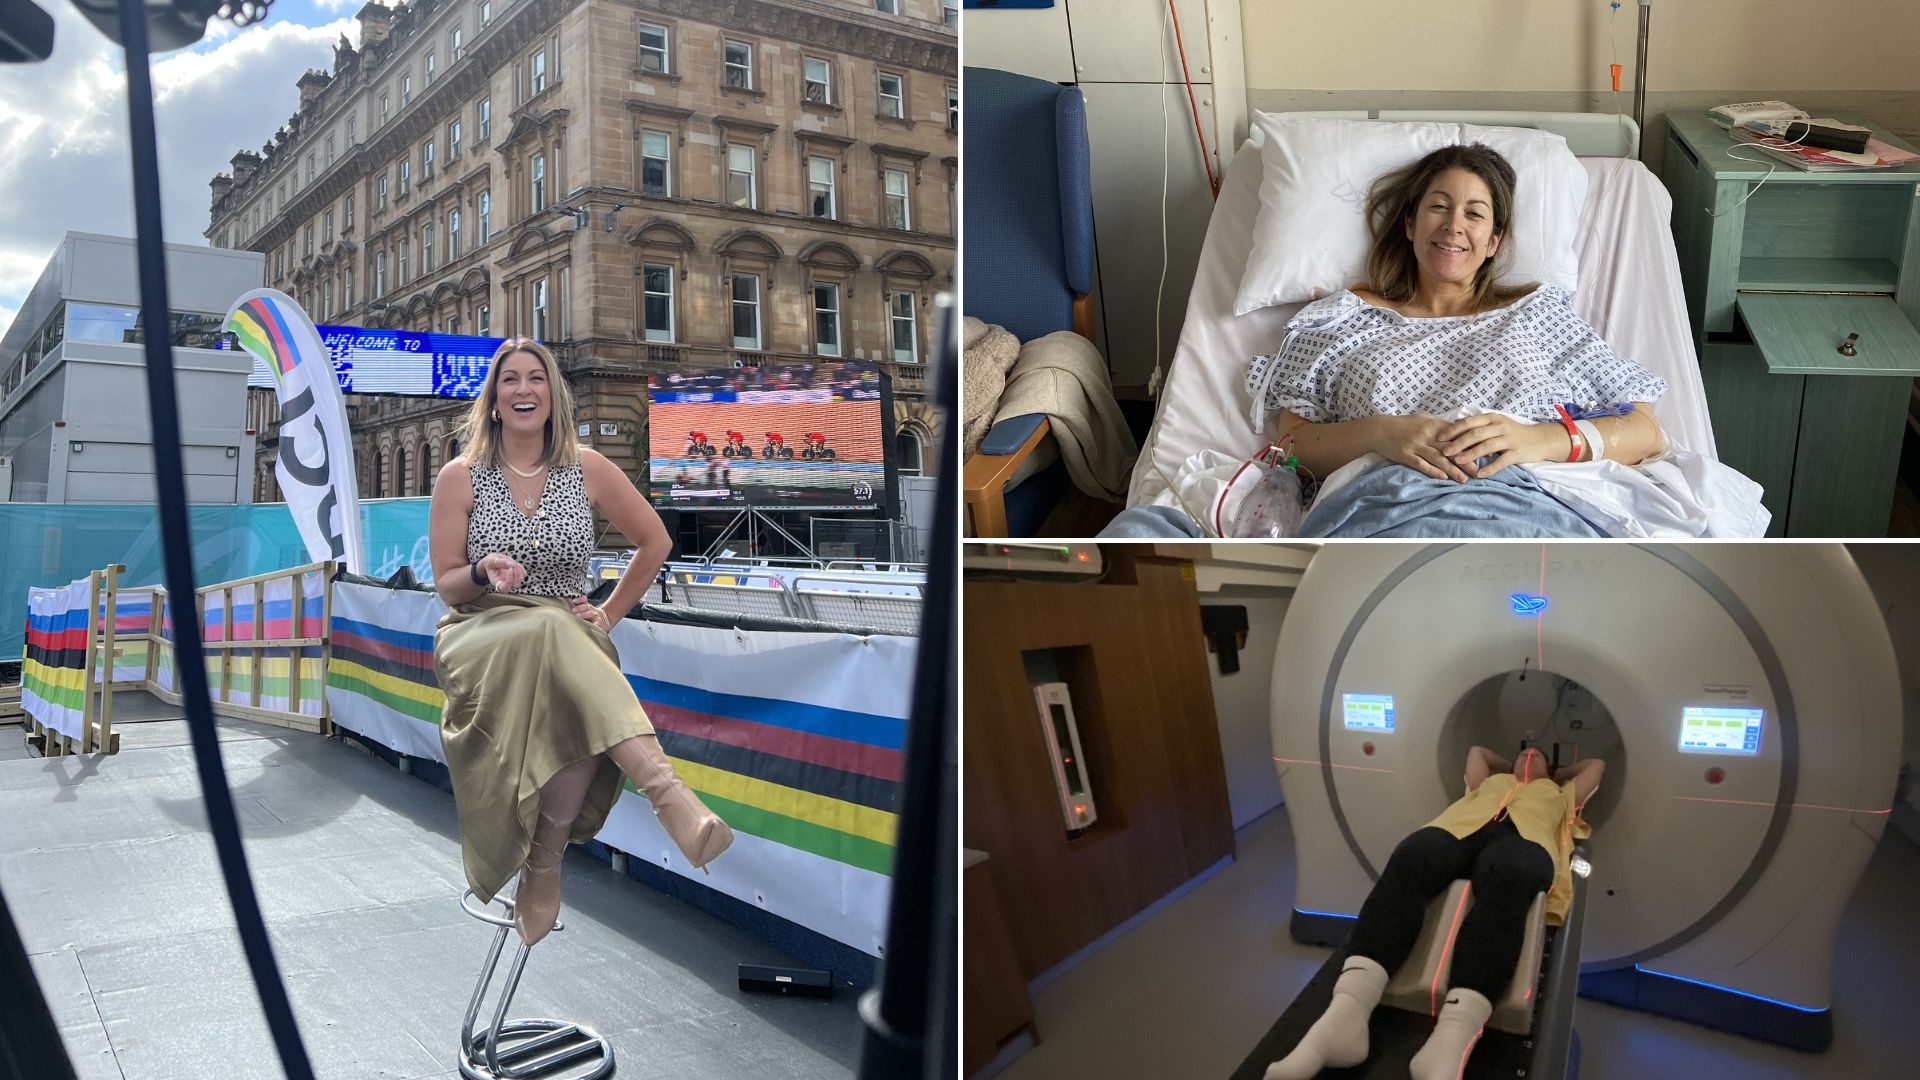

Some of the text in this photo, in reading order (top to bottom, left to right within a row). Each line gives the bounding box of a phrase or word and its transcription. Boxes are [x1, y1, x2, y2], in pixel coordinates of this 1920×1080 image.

[325, 333, 421, 351] WELCOME TO
[1458, 557, 1607, 583] ACCURAY
